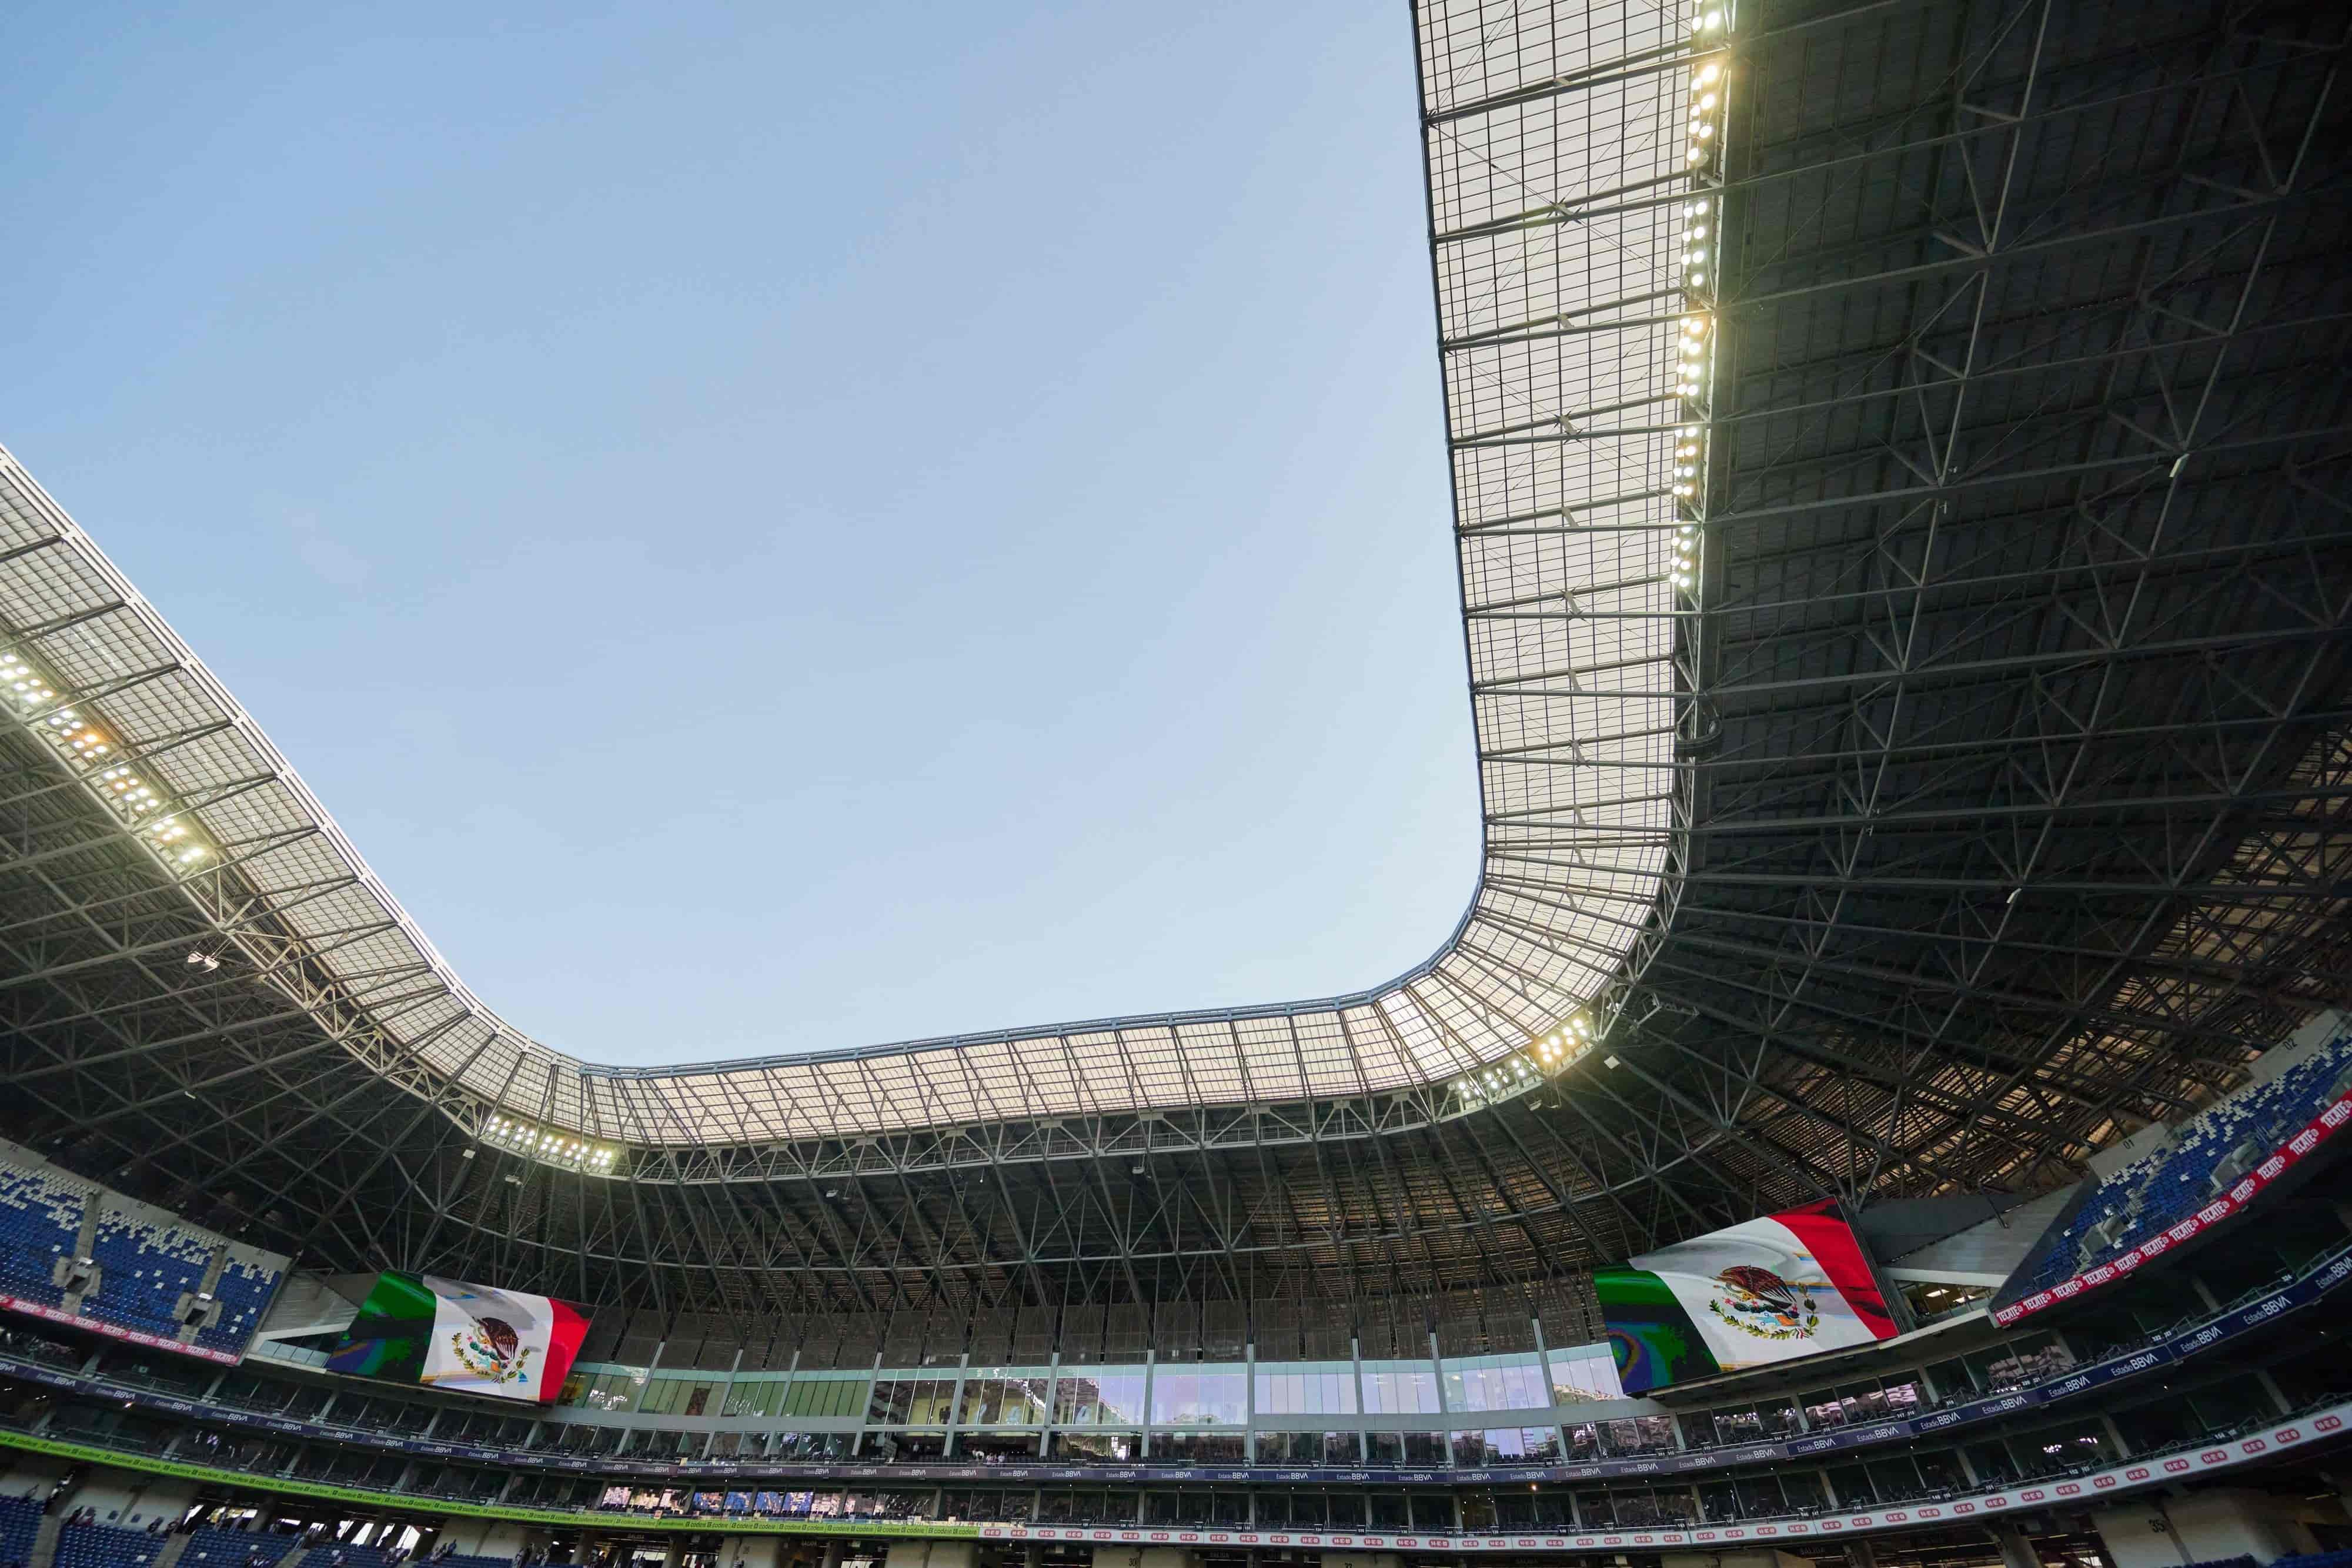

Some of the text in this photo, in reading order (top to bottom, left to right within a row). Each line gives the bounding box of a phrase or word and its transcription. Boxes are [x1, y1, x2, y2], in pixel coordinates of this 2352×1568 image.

[2283, 1038, 2298, 1050] 02
[2320, 1101, 2350, 1128] TECATE
[2123, 1139, 2134, 1149] 01
[2289, 1129, 2317, 1155] TECATE
[2257, 1156, 2282, 1180] TECATE
[2231, 1179, 2253, 1203] TECATE
[2197, 1201, 2226, 1223] TECATE
[2169, 1220, 2196, 1242] TECATE
[2140, 1236, 2166, 1256] TECATE
[2114, 1252, 2139, 1271] TECATE
[2083, 1267, 2110, 1285] TECATE
[2315, 1273, 2335, 1289] Estadio
[2052, 1280, 2079, 1298] TECATE
[2023, 1293, 2047, 1310] TECATE
[2243, 1295, 2291, 1325] Estadio BBVA
[1996, 1305, 2019, 1322] TECATE
[2180, 1326, 2223, 1352] Estadio BBVA
[2111, 1353, 2159, 1376] Estadio BBVA
[2049, 1375, 2090, 1398] Estadio BBVA
[1982, 1396, 2027, 1414] Estadio BBVA
[1920, 1412, 1961, 1430] Estadio BBVA
[1857, 1427, 1900, 1442] Estadio BBVA
[1753, 1448, 1776, 1458] BBVA
[1797, 1438, 1837, 1453] Estadio BBVA
[1637, 1463, 1658, 1472] BBVA
[1695, 1456, 1716, 1466] BBVA
[1581, 1467, 1601, 1476] BBVA
[2149, 1519, 2164, 1533] 35
